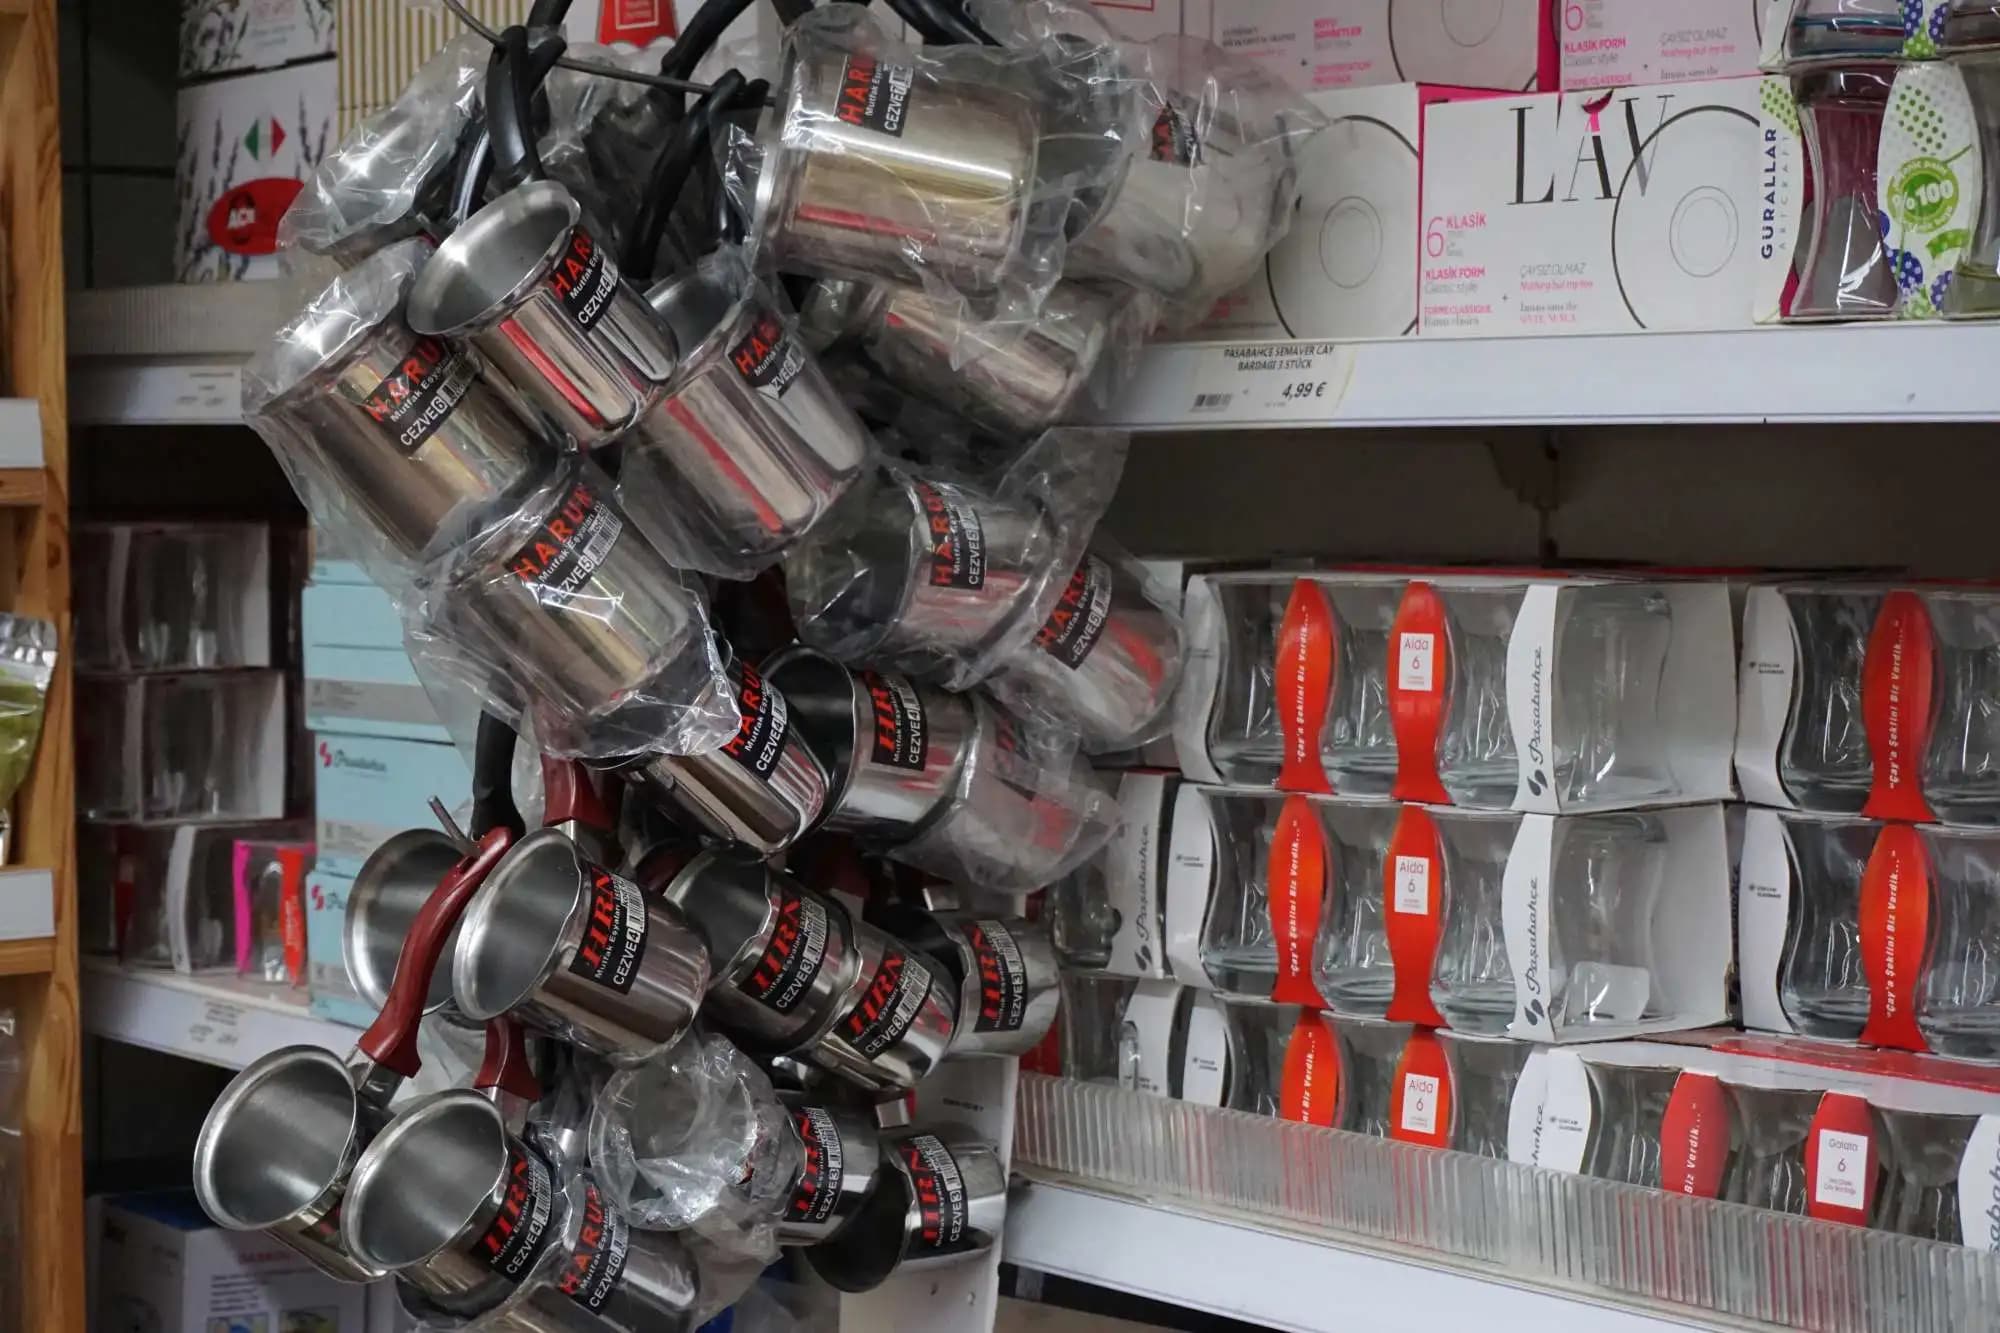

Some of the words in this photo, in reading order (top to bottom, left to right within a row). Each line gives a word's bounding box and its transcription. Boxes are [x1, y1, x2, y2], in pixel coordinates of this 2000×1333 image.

[1599, 36, 1627, 49] FORM
[884, 91, 905, 131] CEZVE
[1761, 128, 1777, 260] GÜRALLAR
[1426, 216, 1445, 258] 6
[1446, 212, 1487, 229] KLASİK
[569, 267, 593, 300] Mutfak
[1458, 267, 1486, 279] FORM
[578, 282, 610, 325] CEZVE
[365, 340, 441, 421] HARU
[1285, 358, 1312, 370] STÜCK
[390, 390, 422, 422] Mutfak
[1282, 382, 1313, 401] 4,99
[1315, 381, 1327, 397] €
[400, 406, 438, 446] CEZVE
[513, 482, 593, 581] HARUN
[538, 550, 570, 582] Mutfak
[968, 540, 980, 585] CEZVE
[1056, 611, 1080, 645] Mutfak
[1405, 638, 1429, 650] Aida
[1296, 664, 1305, 682] Biz
[1412, 656, 1420, 669] 6
[1528, 646, 1543, 766] Paşabahçe
[1889, 684, 1899, 702] Biz
[744, 717, 764, 752] Mutfak
[756, 729, 781, 771] CEZVE
[909, 720, 921, 764] CEZVE
[1400, 861, 1424, 874] Aida
[1289, 879, 1297, 897] Biz
[1408, 879, 1416, 893] 6
[1525, 877, 1541, 995] Paşabahçe
[1886, 914, 1896, 932] Biz
[595, 944, 613, 978] Mutfak
[613, 941, 637, 985] CEZVE
[627, 930, 640, 943] 4
[776, 971, 808, 1008] CEZVE
[801, 959, 814, 975] 3
[1012, 973, 1023, 985] 3
[1009, 983, 1023, 1025] CEZVE
[1302, 1089, 1311, 1108] Biz
[1409, 1079, 1434, 1093] Aida
[1416, 1098, 1424, 1111] 6
[1828, 1139, 1859, 1152] Galata
[1837, 1158, 1847, 1172] 6
[816, 1178, 837, 1220] CEZVE
[829, 1168, 839, 1181] 3
[950, 1190, 962, 1203] 3
[1684, 1173, 1694, 1194] Biz
[950, 1201, 963, 1242] CEZVE
[506, 1233, 537, 1274] CEZVE
[530, 1221, 543, 1237] 4
[580, 1253, 601, 1289] Mutfak
[589, 1262, 617, 1308] CEZVE
